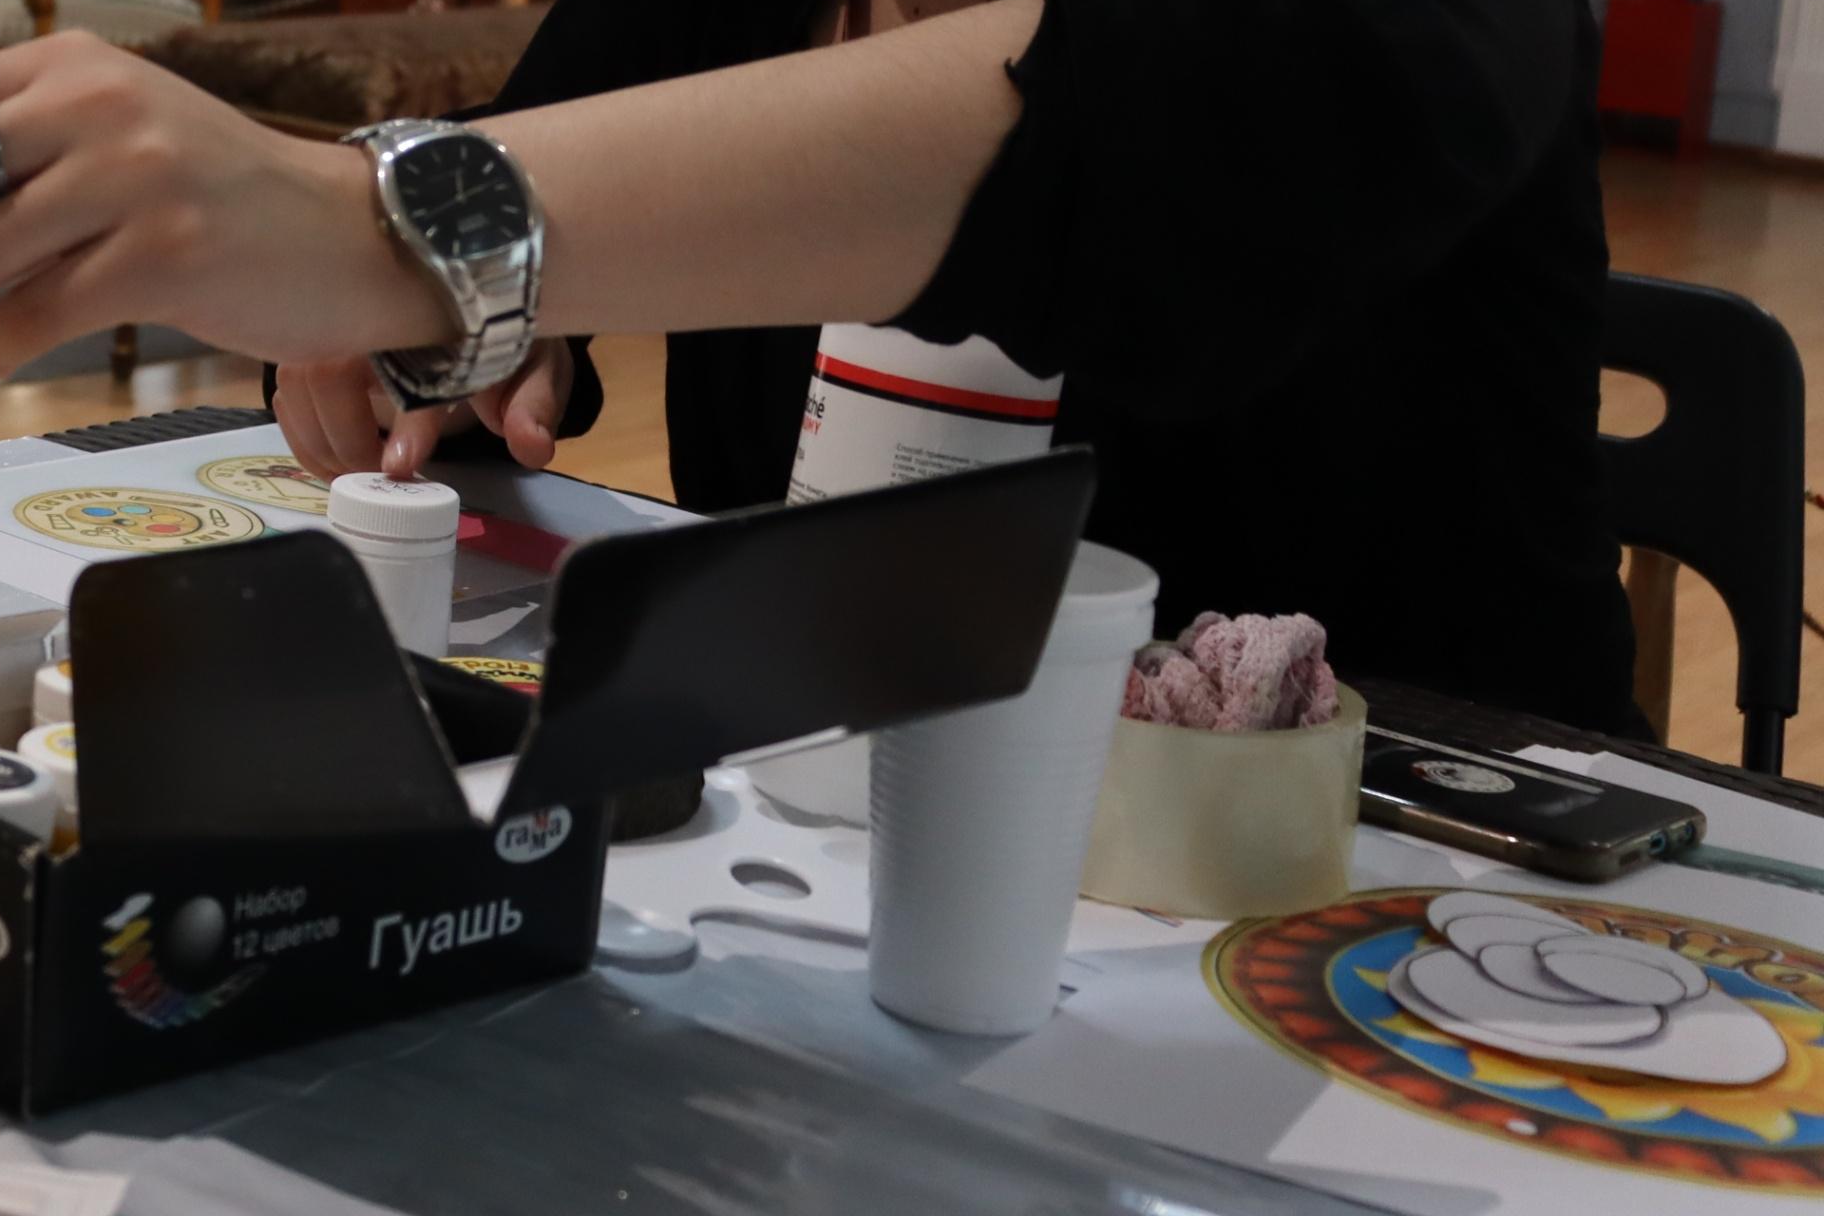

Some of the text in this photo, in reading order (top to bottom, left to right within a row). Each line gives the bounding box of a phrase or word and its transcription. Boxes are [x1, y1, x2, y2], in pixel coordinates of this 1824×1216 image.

[33, 490, 120, 512] AWARD
[234, 886, 307, 922] Набор
[233, 916, 340, 959] 12 цветов
[369, 898, 524, 976] Гуашь
